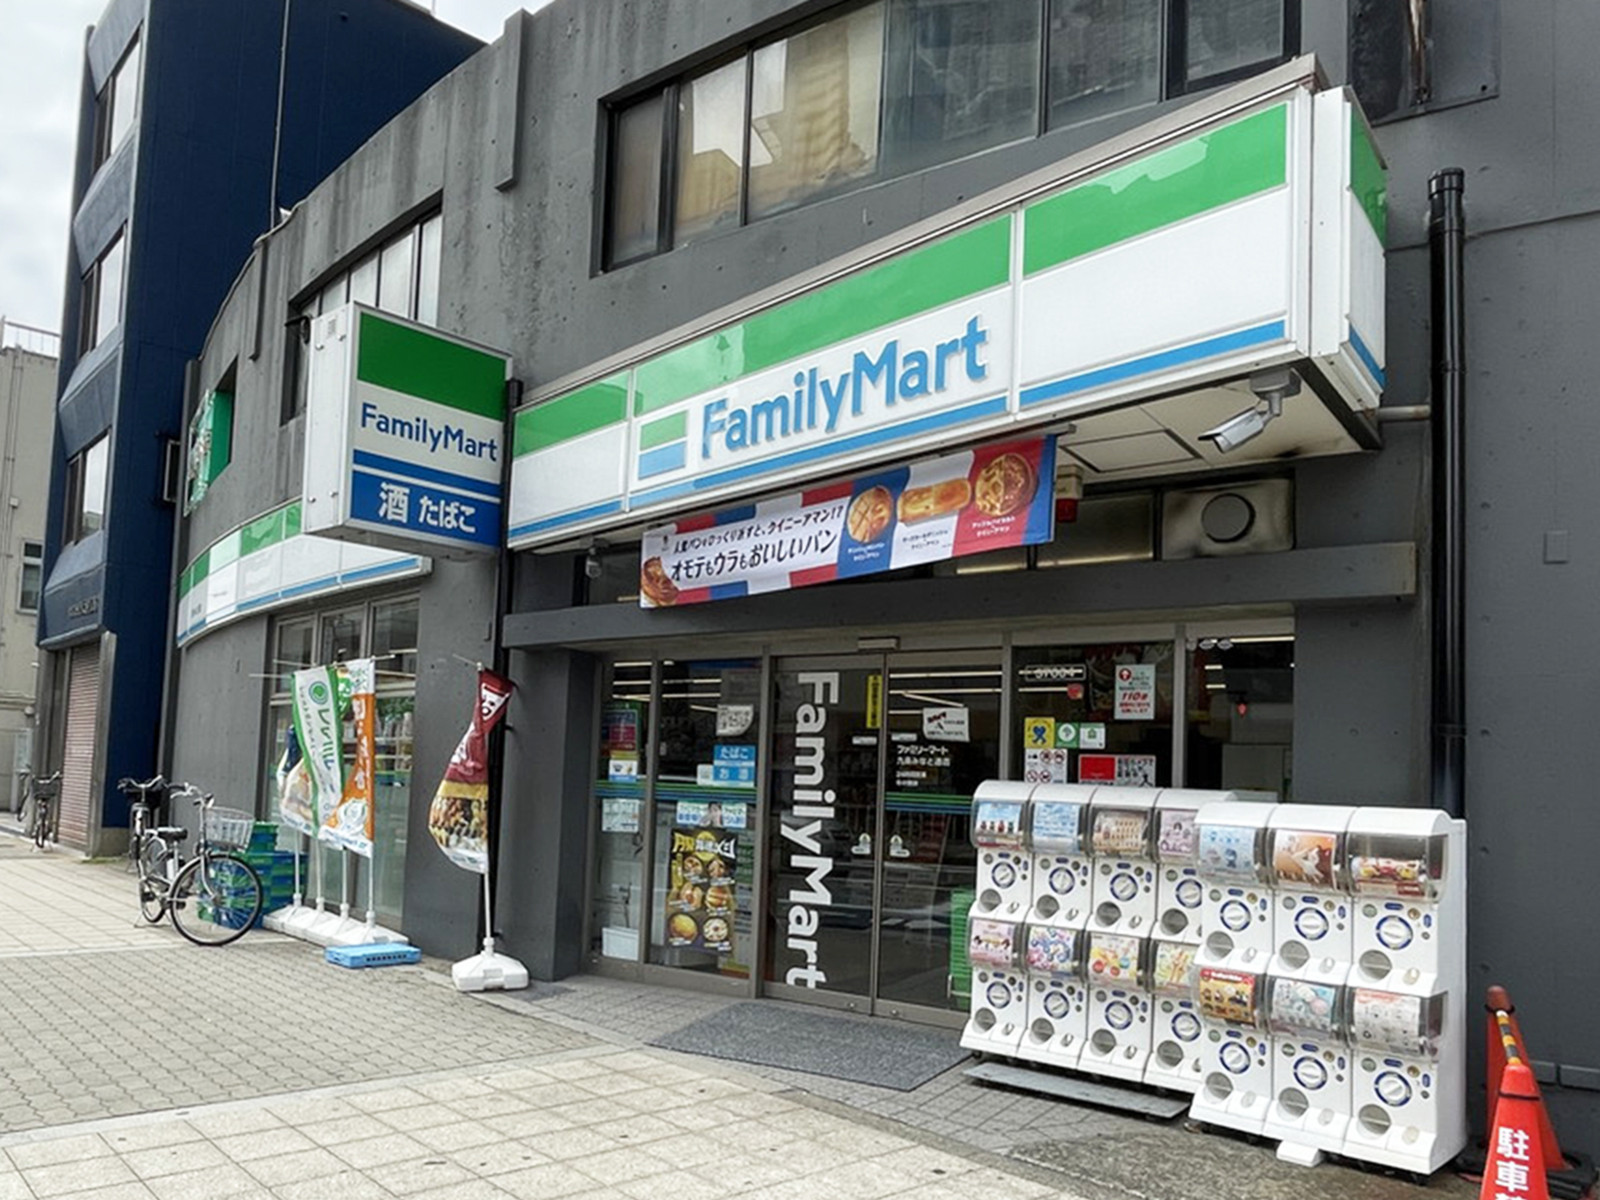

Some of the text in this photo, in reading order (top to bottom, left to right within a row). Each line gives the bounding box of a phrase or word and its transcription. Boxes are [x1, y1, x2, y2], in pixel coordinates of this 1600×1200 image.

[702, 315, 988, 459] FamilyMart
[361, 402, 498, 462] FamilyMart
[378, 481, 476, 533] 酒 たばこ
[671, 529, 838, 582] オモテもウラもおいしいパン
[721, 746, 749, 760] たばこ
[897, 744, 950, 756] ファミリーマート
[780, 671, 839, 989] FamilyMart
[1495, 1126, 1530, 1200] 駐車
